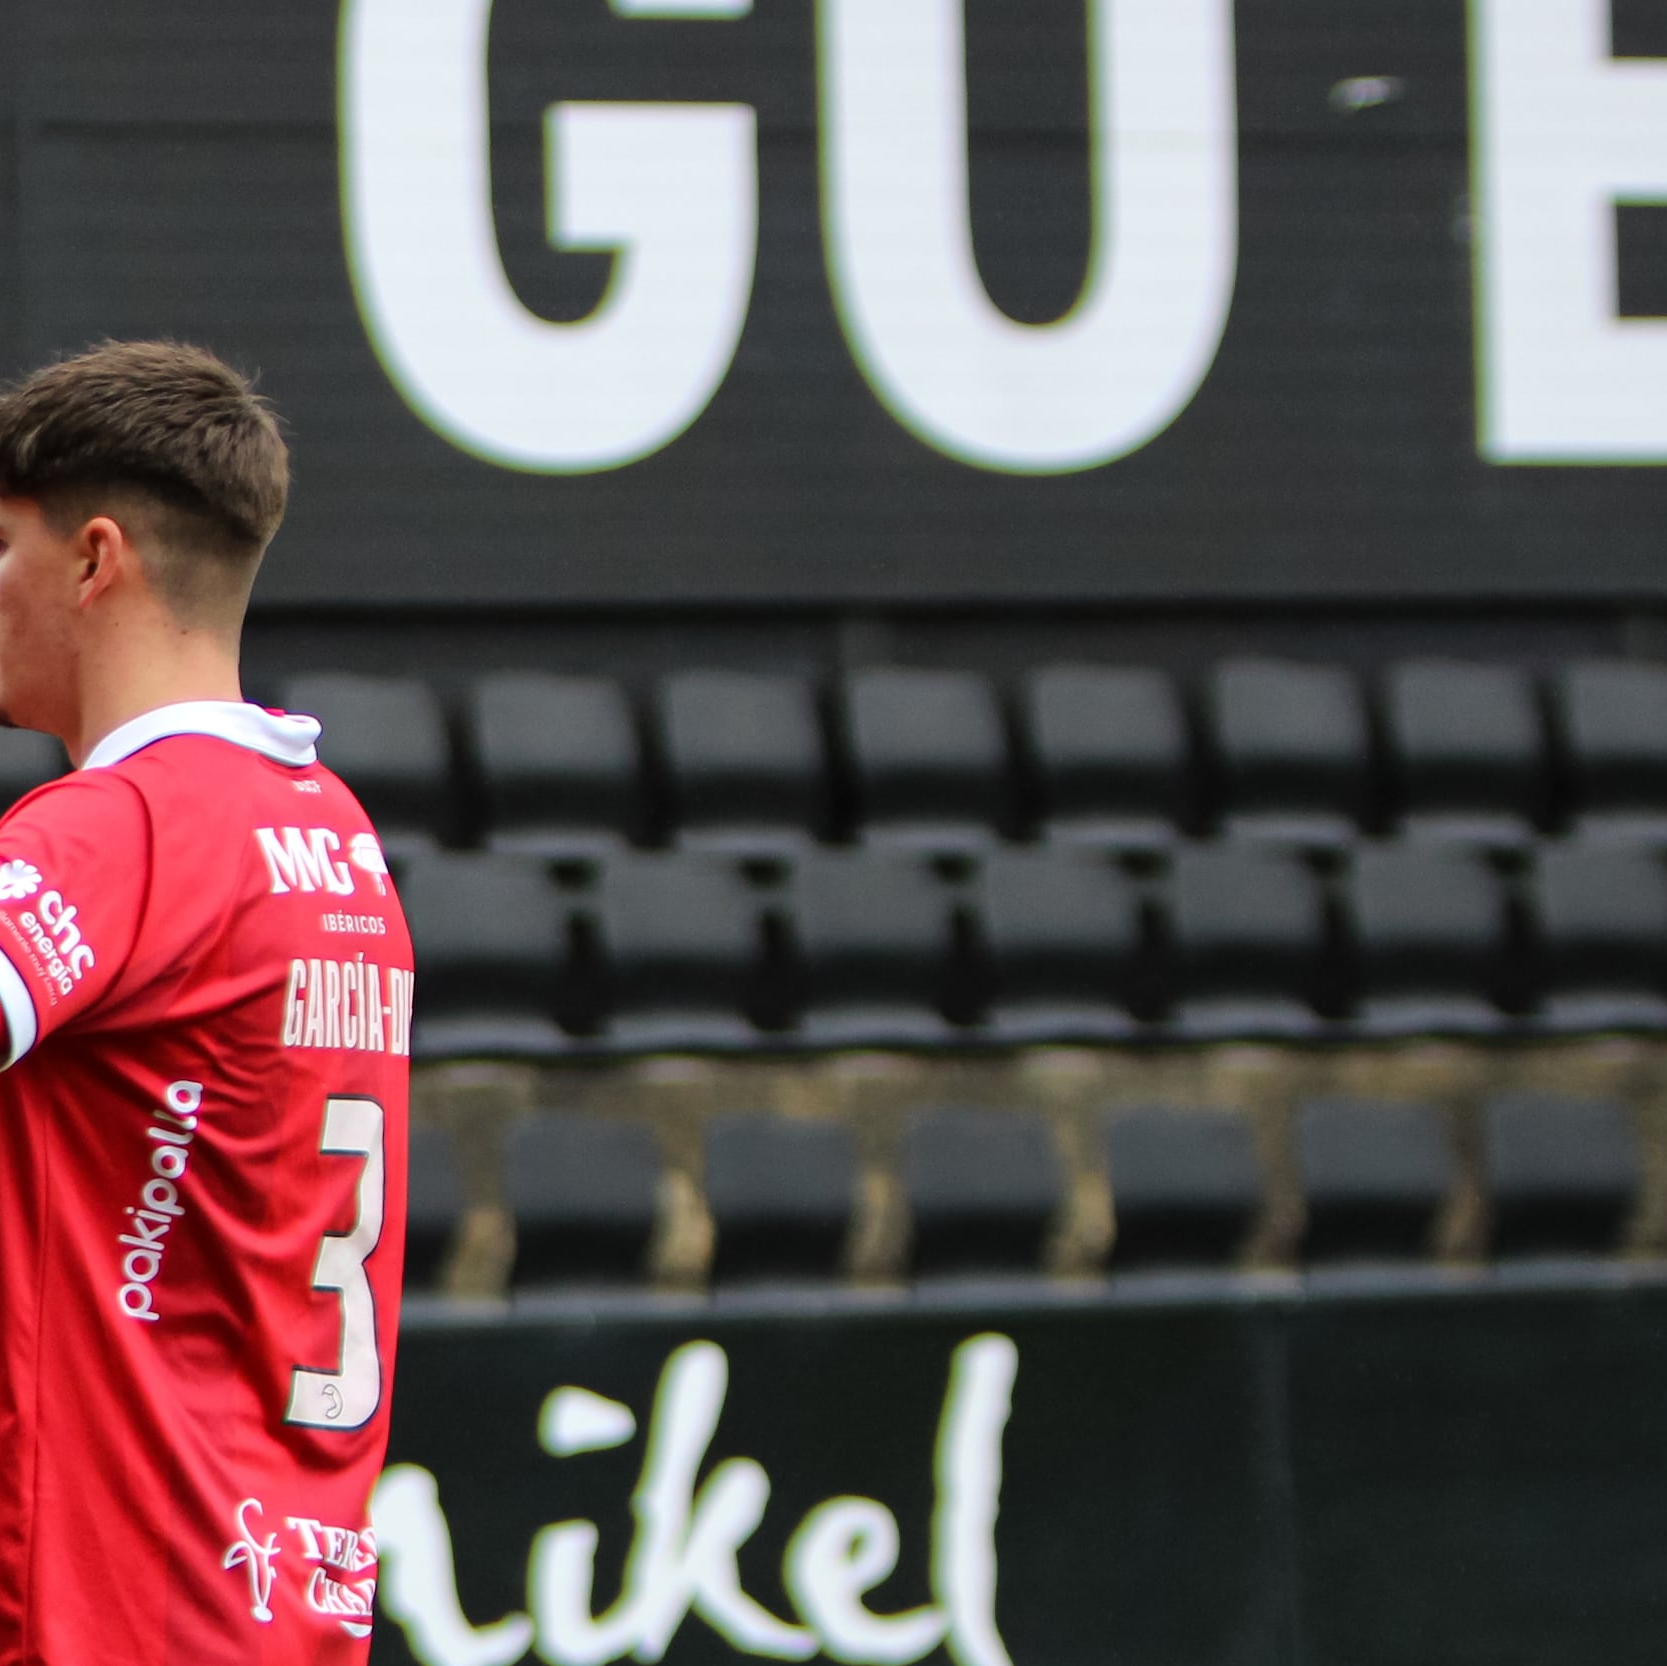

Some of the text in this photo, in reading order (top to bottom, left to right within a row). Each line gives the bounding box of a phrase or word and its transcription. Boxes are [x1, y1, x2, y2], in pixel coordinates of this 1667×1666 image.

[19, 911, 74, 996] energía
[38, 889, 95, 980] chc
[321, 909, 387, 935] IBÉRICOS
[282, 1092, 386, 1432] 3
